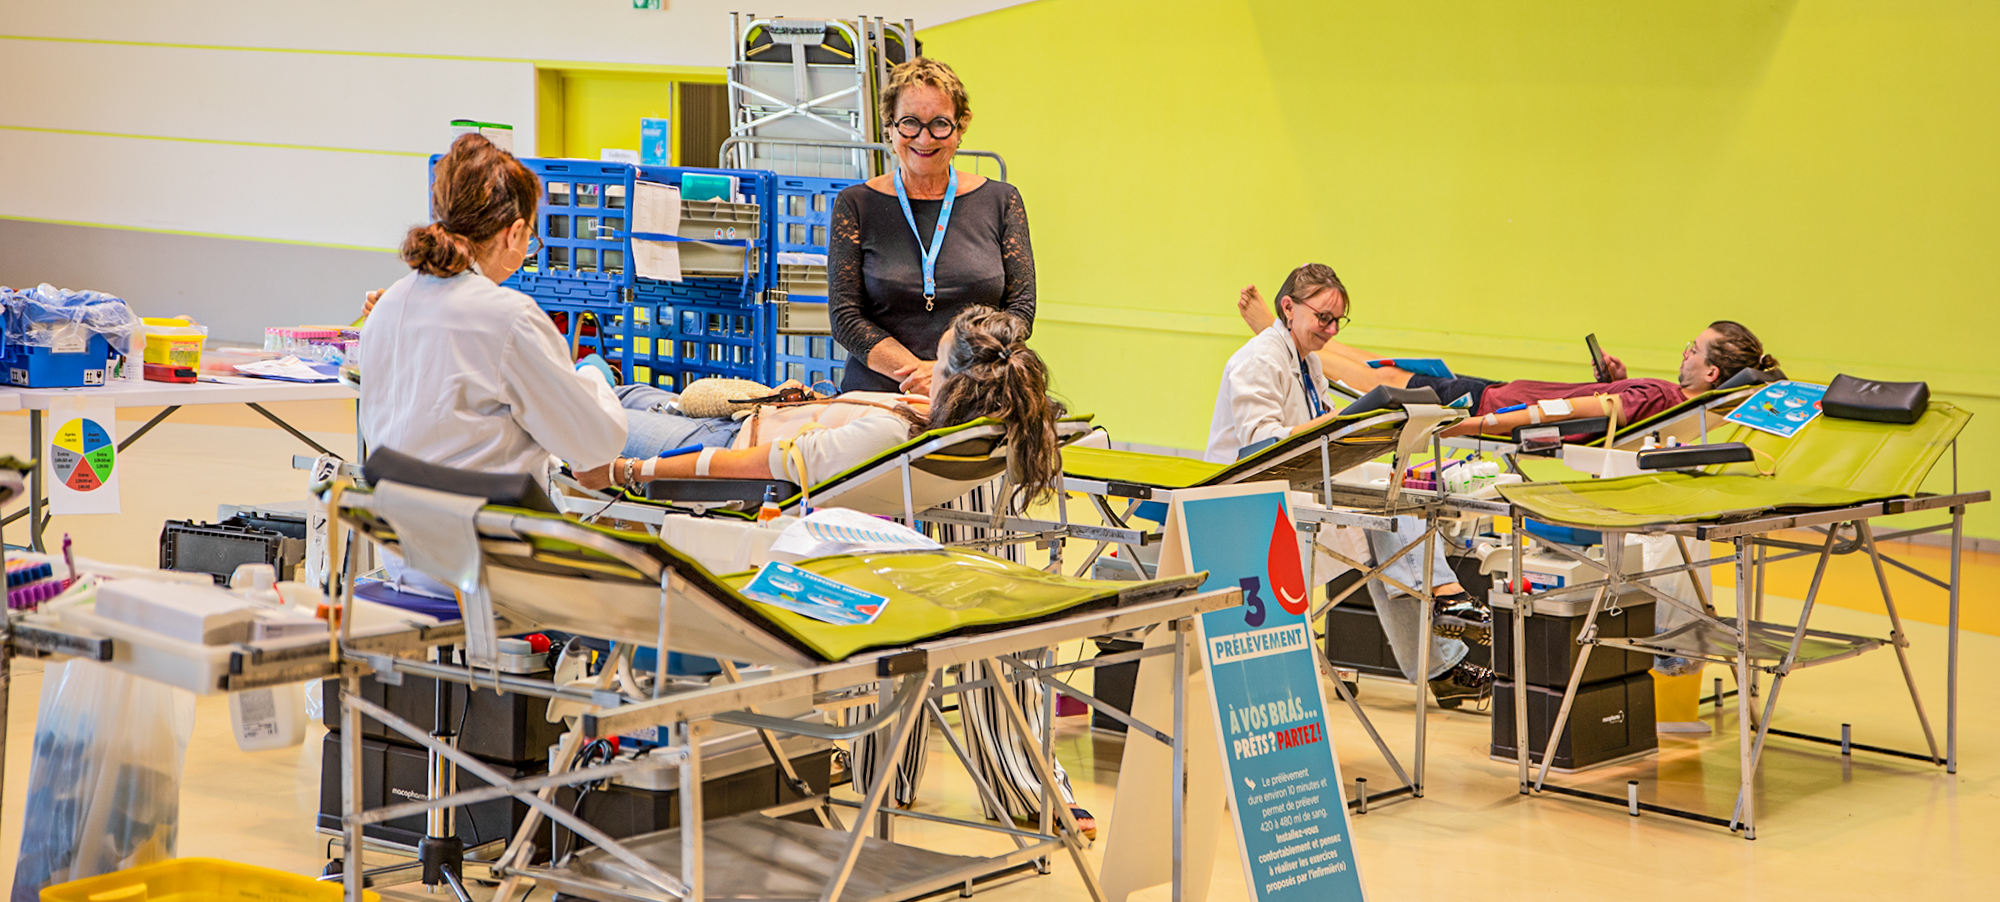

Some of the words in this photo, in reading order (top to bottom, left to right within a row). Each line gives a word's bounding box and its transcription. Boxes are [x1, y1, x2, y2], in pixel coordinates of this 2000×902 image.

[1239, 576, 1266, 627] 3
[1215, 628, 1303, 659] PRÉLÈVEMENT
[1229, 703, 1241, 735] À
[1239, 703, 1269, 732] VOS
[1267, 696, 1318, 727] BRAS...
[1276, 721, 1322, 751] PARTEZ!
[1261, 777, 1271, 788] Le
[1271, 767, 1309, 787] prélèvement
[1247, 795, 1263, 806] dure
[1264, 789, 1288, 802] environ
[1287, 785, 1296, 796] 10
[1296, 780, 1320, 793] minutes
[1320, 778, 1328, 788] et
[1262, 804, 1286, 819] permet
[1286, 800, 1295, 811] de
[1295, 794, 1320, 810] prélever
[1260, 820, 1274, 833] 420
[1274, 820, 1280, 829] à
[1279, 815, 1294, 827] 480
[1293, 814, 1302, 824] ml
[1302, 811, 1311, 822] de
[1311, 808, 1328, 820] sang.
[1275, 825, 1319, 844] Installez-vous
[1258, 841, 1312, 864] confortablement
[1312, 839, 1319, 849] et
[1319, 833, 1342, 850] pensez
[1268, 865, 1275, 876] à
[1275, 860, 1298, 876] réaliser
[1298, 856, 1309, 868] les
[1309, 849, 1338, 865] exercices
[1266, 875, 1297, 895] proposés
[1296, 872, 1308, 886] par
